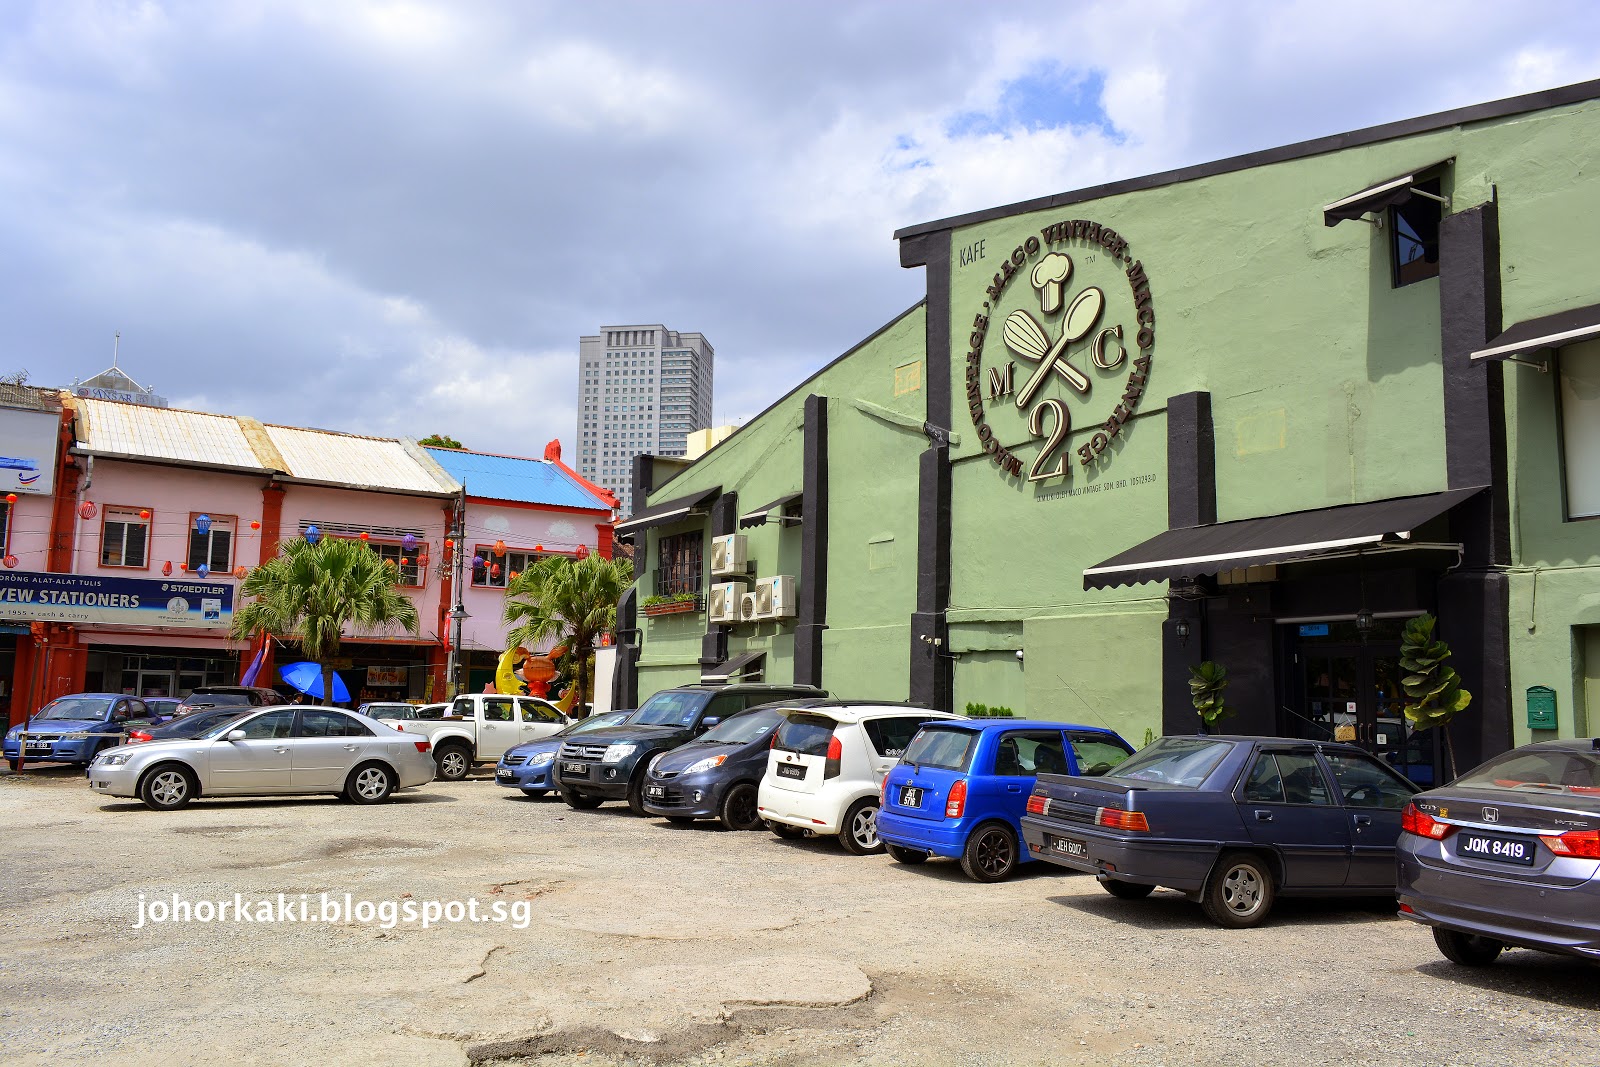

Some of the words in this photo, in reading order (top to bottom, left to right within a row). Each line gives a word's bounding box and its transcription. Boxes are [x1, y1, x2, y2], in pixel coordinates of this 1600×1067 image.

[959, 239, 986, 268] KAFE
[987, 236, 1040, 300] MACO
[1040, 219, 1129, 258] VINTAGE
[1125, 260, 1155, 350] MACO
[1091, 324, 1127, 369] C
[965, 312, 989, 426] VINTAGE
[987, 361, 1017, 400] M
[1077, 354, 1153, 466] VINTAGE
[977, 423, 1024, 478] MACO
[1028, 398, 1070, 482] 2
[1082, 483, 1101, 495] VINTAGE
[0, 587, 35, 603] YEW
[38, 589, 140, 609] STATIONERS
[32, 577, 77, 586] ALAT-ALAT
[79, 579, 102, 587] TULIS
[170, 584, 225, 595] STAEDTLER
[1056, 840, 1068, 852] JEH
[1464, 837, 1490, 854] JQK
[1492, 840, 1524, 858] 8419
